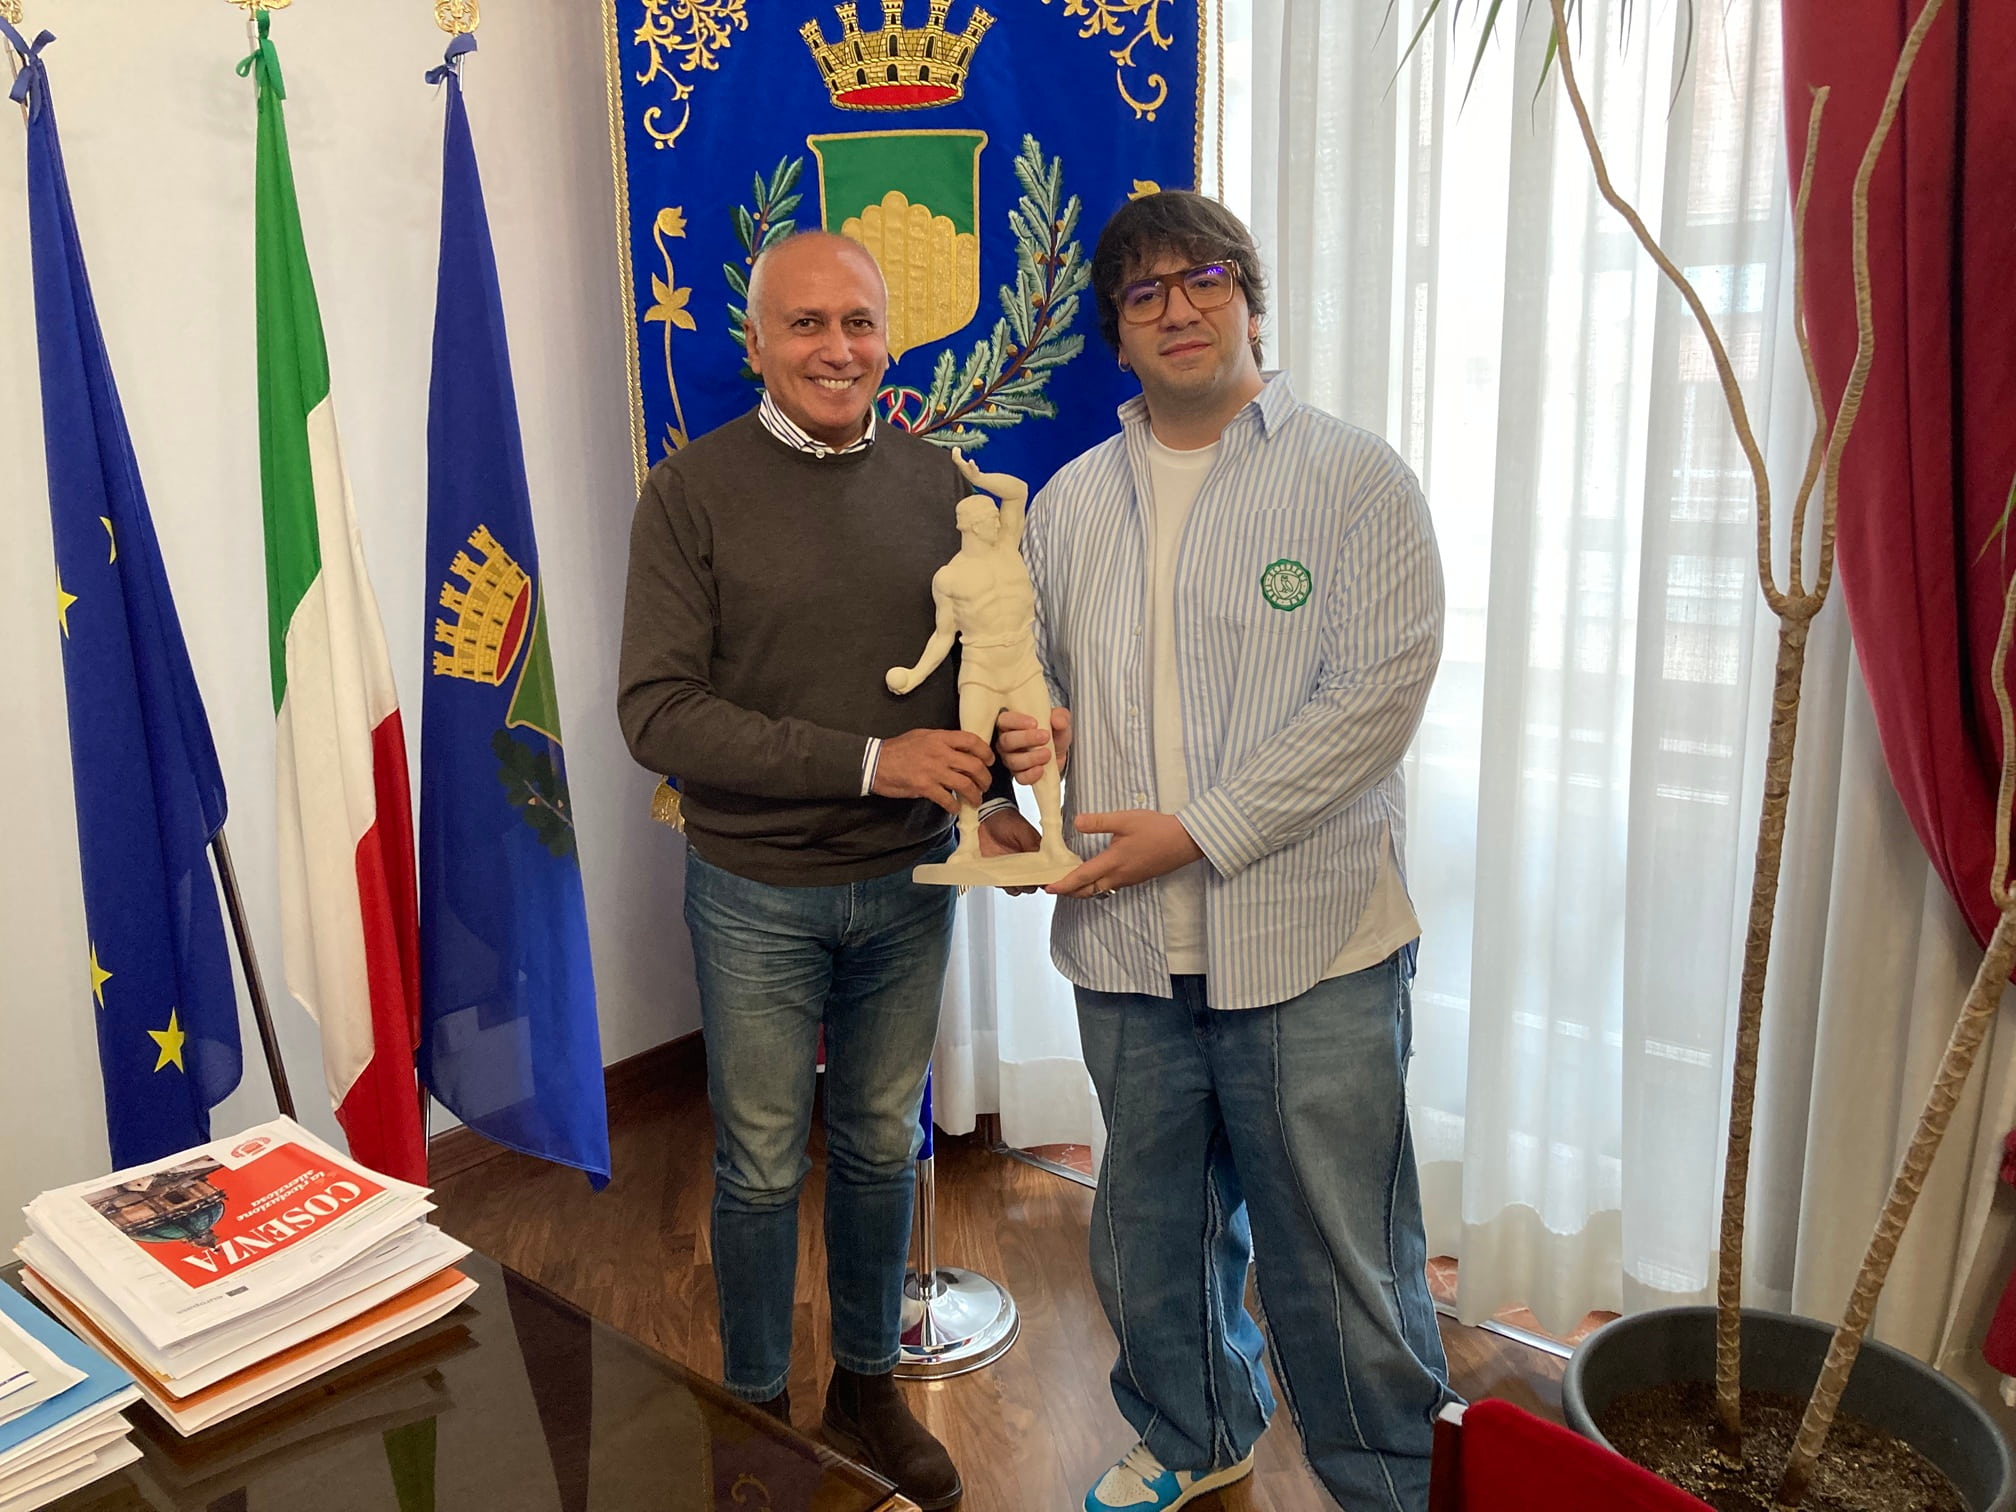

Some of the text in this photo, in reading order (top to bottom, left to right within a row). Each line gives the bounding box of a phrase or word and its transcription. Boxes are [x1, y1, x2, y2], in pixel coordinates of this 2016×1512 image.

[236, 1171, 326, 1222] la rivoluzione
[250, 1169, 315, 1207] silenziosa
[181, 1180, 362, 1274] COSENZA
